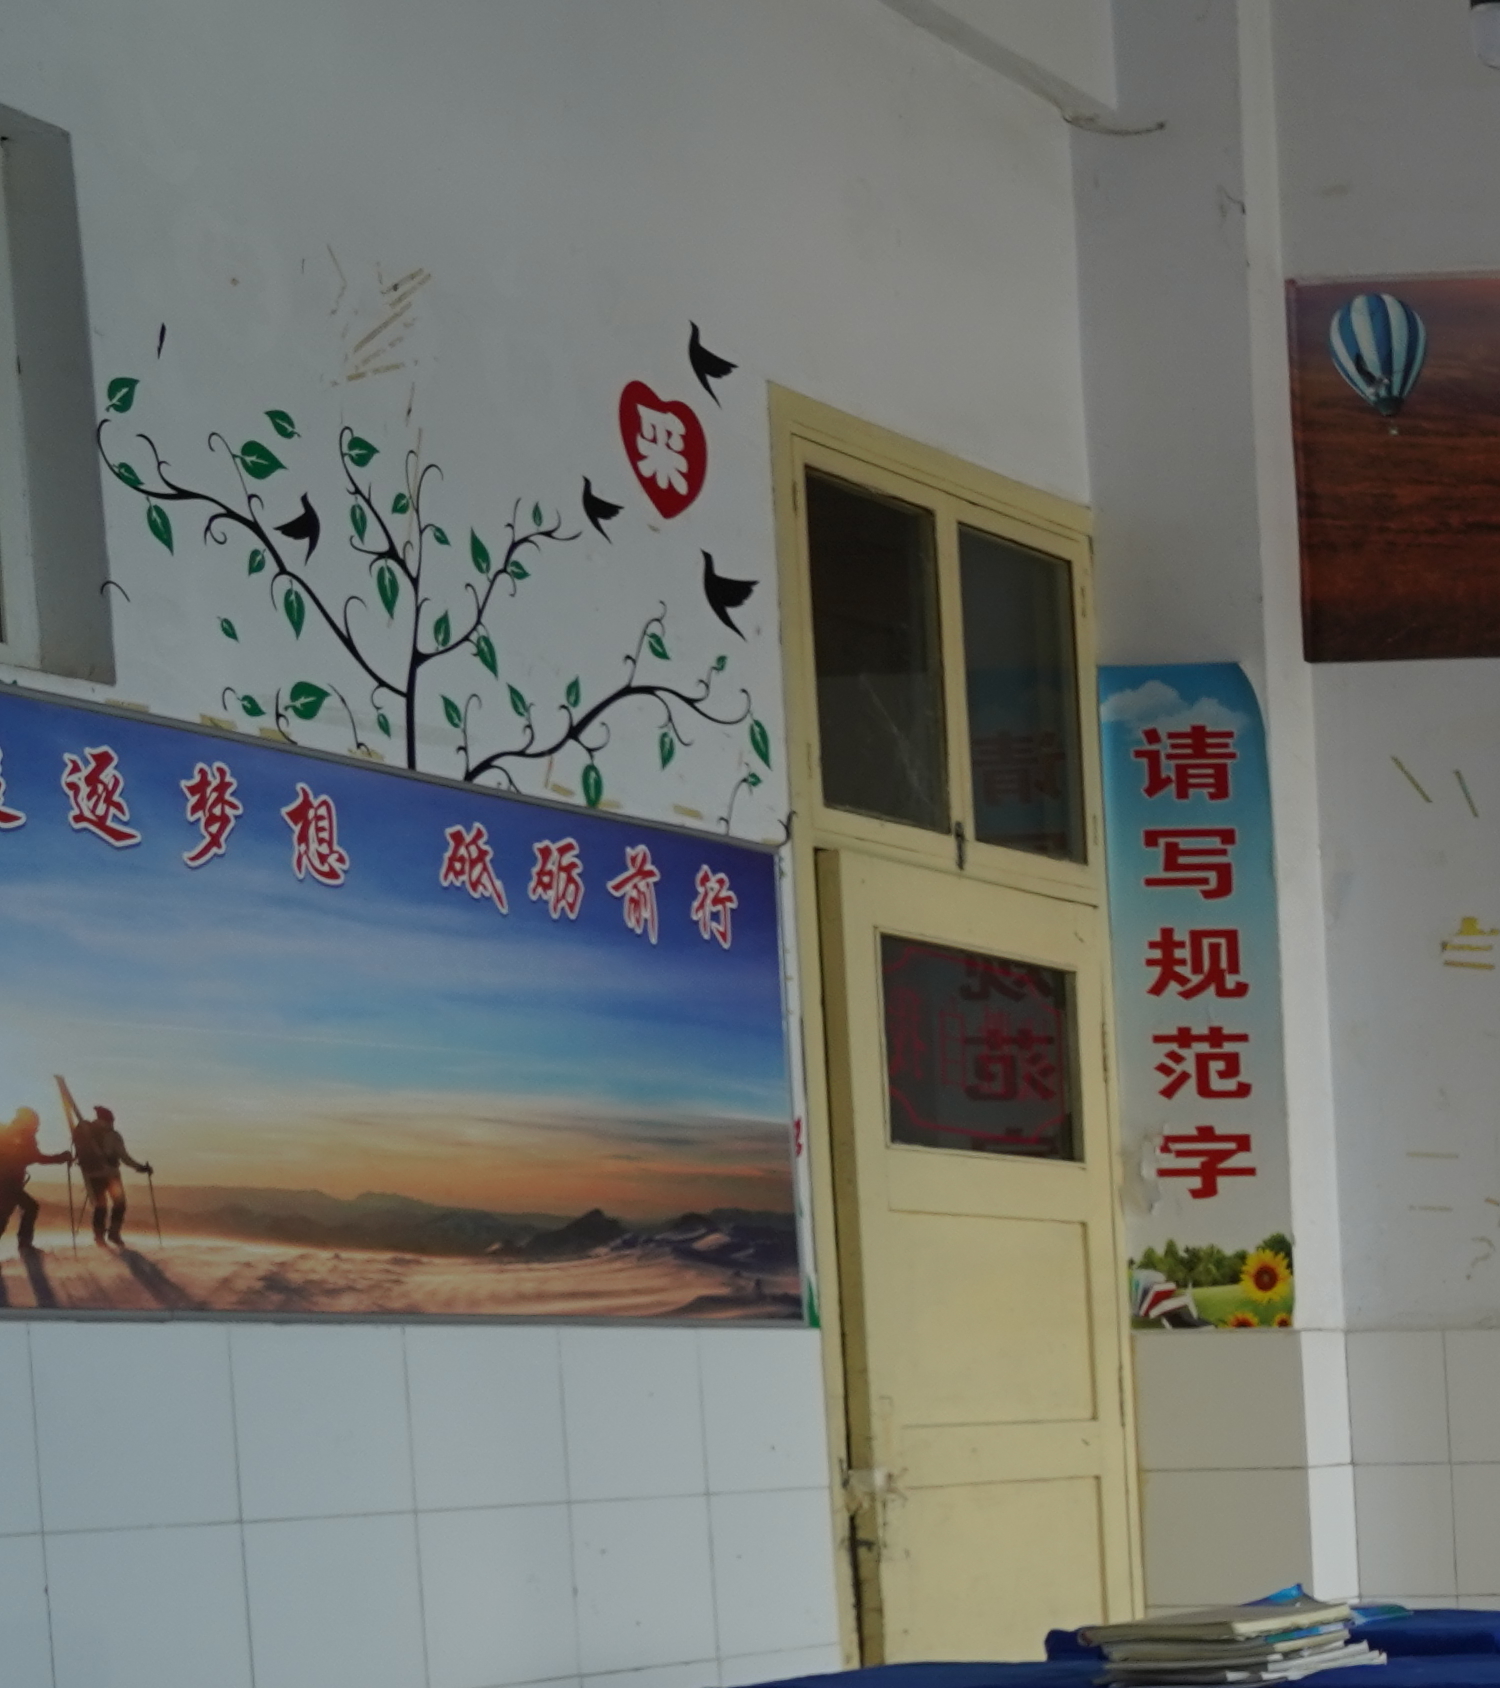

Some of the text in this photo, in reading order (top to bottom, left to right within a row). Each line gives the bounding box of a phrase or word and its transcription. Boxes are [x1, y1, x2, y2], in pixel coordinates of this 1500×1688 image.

[633, 403, 690, 496] 采
[0, 745, 738, 949] 逐梦想 砥砺前行
[1131, 724, 1258, 1201] 请写规范字
